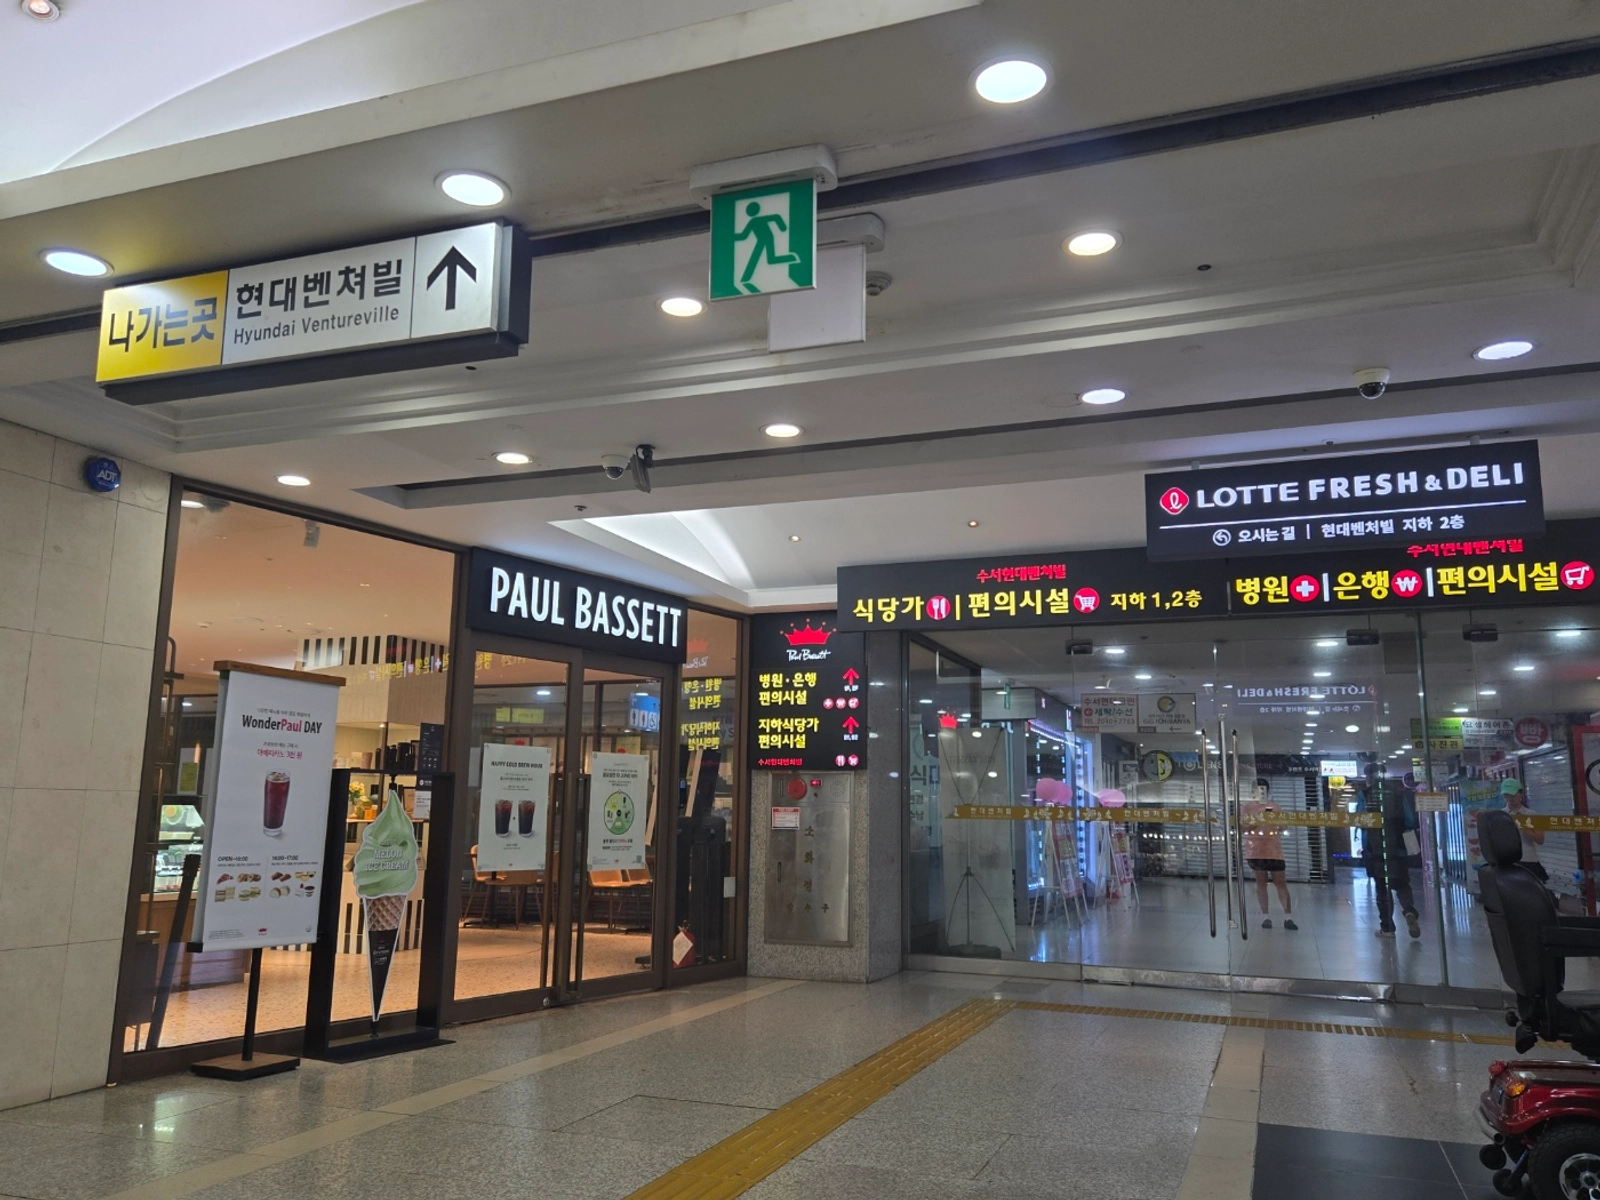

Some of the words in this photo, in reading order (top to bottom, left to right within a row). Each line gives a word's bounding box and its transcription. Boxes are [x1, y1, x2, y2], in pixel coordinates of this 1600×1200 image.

[236, 259, 402, 319] 현대벤쳐빌
[109, 296, 218, 352] 나가는곳
[234, 320, 295, 345] Hyundai
[302, 305, 399, 334] Ventureville
[97, 469, 117, 482] ADT
[1197, 482, 1299, 508] LOTTE
[1321, 519, 1394, 539] 현대벤처빌
[1402, 517, 1433, 532] 지하
[1440, 514, 1465, 531] 2층
[1236, 575, 1289, 605] 병원
[1333, 571, 1390, 600] 은행
[1437, 561, 1560, 595] 편의시설
[490, 566, 565, 626] PAUL
[575, 586, 681, 647] BASSETT
[852, 595, 924, 623] 식당가
[968, 587, 1070, 618] 편의시설
[1110, 592, 1146, 611] 지하
[1151, 589, 1203, 609] 1,2층
[758, 690, 807, 706] 편의시설
[242, 714, 302, 732] WonderPaul
[304, 721, 322, 733] DAY
[758, 718, 819, 732] 지하식당가
[758, 734, 806, 749] 편의시설
[380, 860, 410, 871] CREAM
